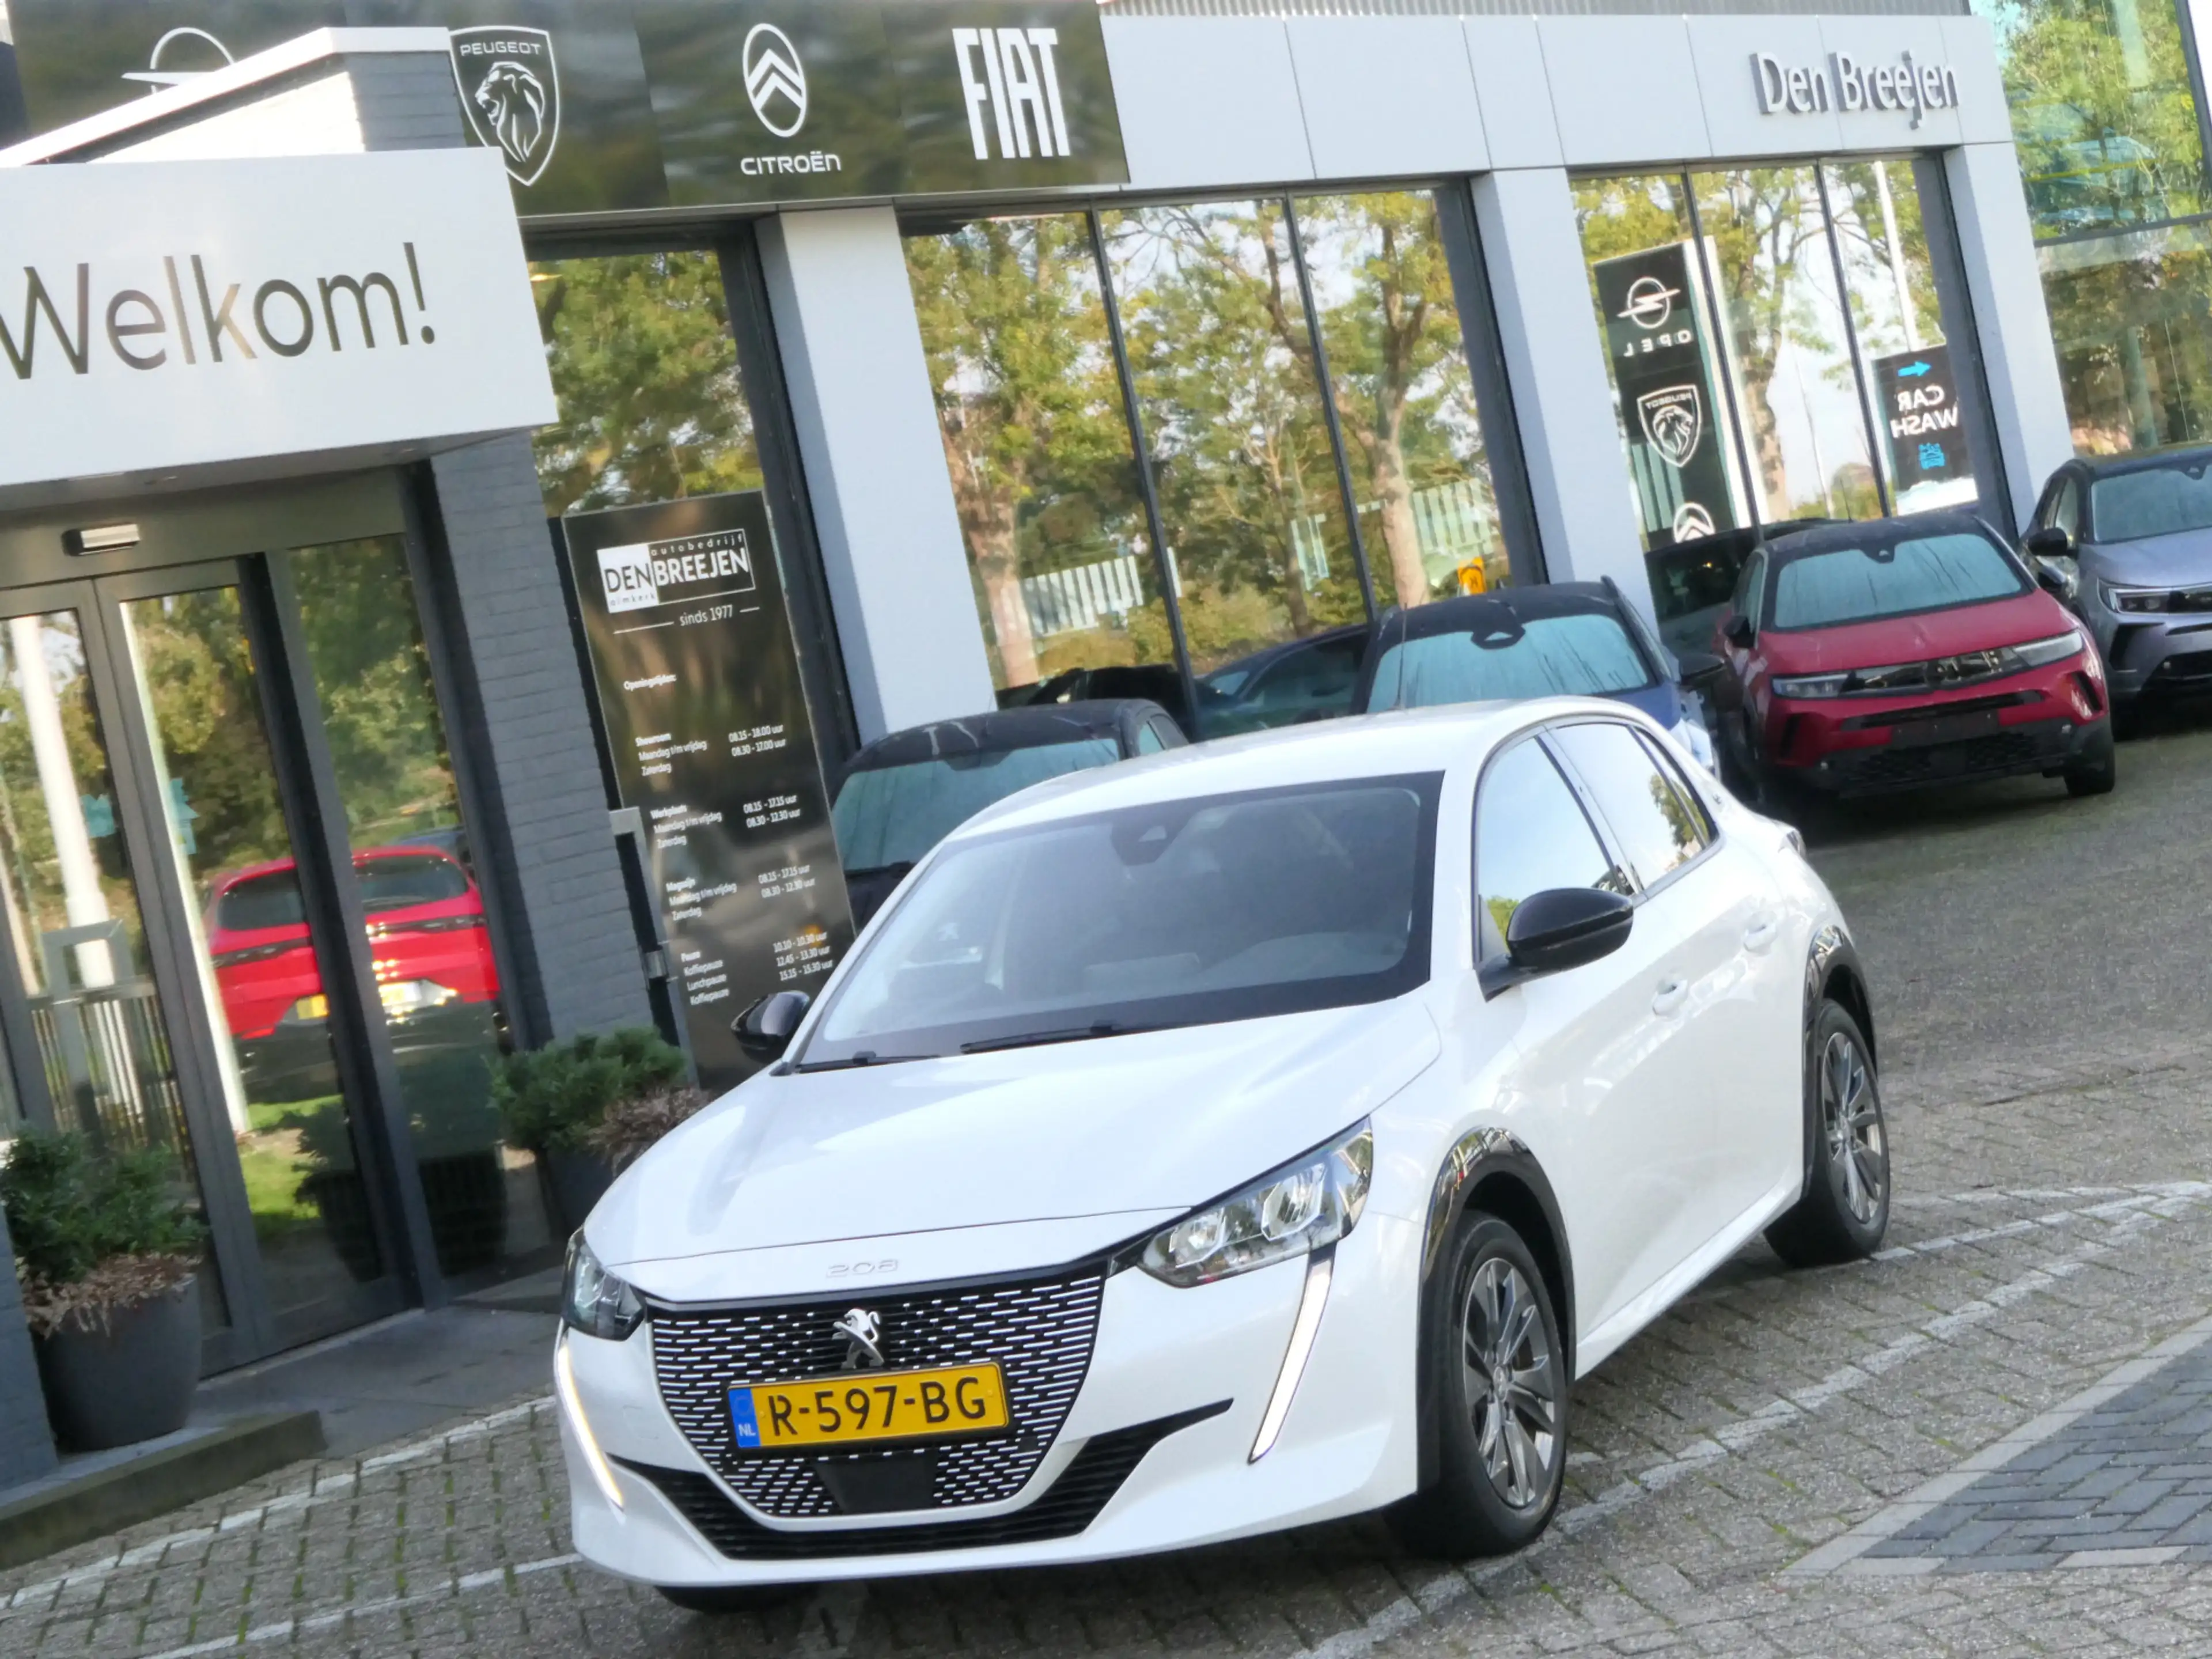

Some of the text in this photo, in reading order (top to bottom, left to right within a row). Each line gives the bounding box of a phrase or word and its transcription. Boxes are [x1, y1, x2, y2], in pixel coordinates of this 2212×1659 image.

[460, 41, 541, 56] PEUGEOT
[952, 28, 1070, 160] FIAT
[1749, 48, 1961, 130] Den Breejen
[740, 150, 842, 175] CITROËN
[0, 242, 435, 380] Welkom!
[651, 533, 743, 556] autobedrijf
[604, 548, 749, 593] DEN BREEJEN
[680, 604, 733, 627] sinds 1977
[826, 1259, 899, 1278] 208
[768, 1377, 986, 1436] R-597-BG
[738, 1423, 756, 1437] NL
